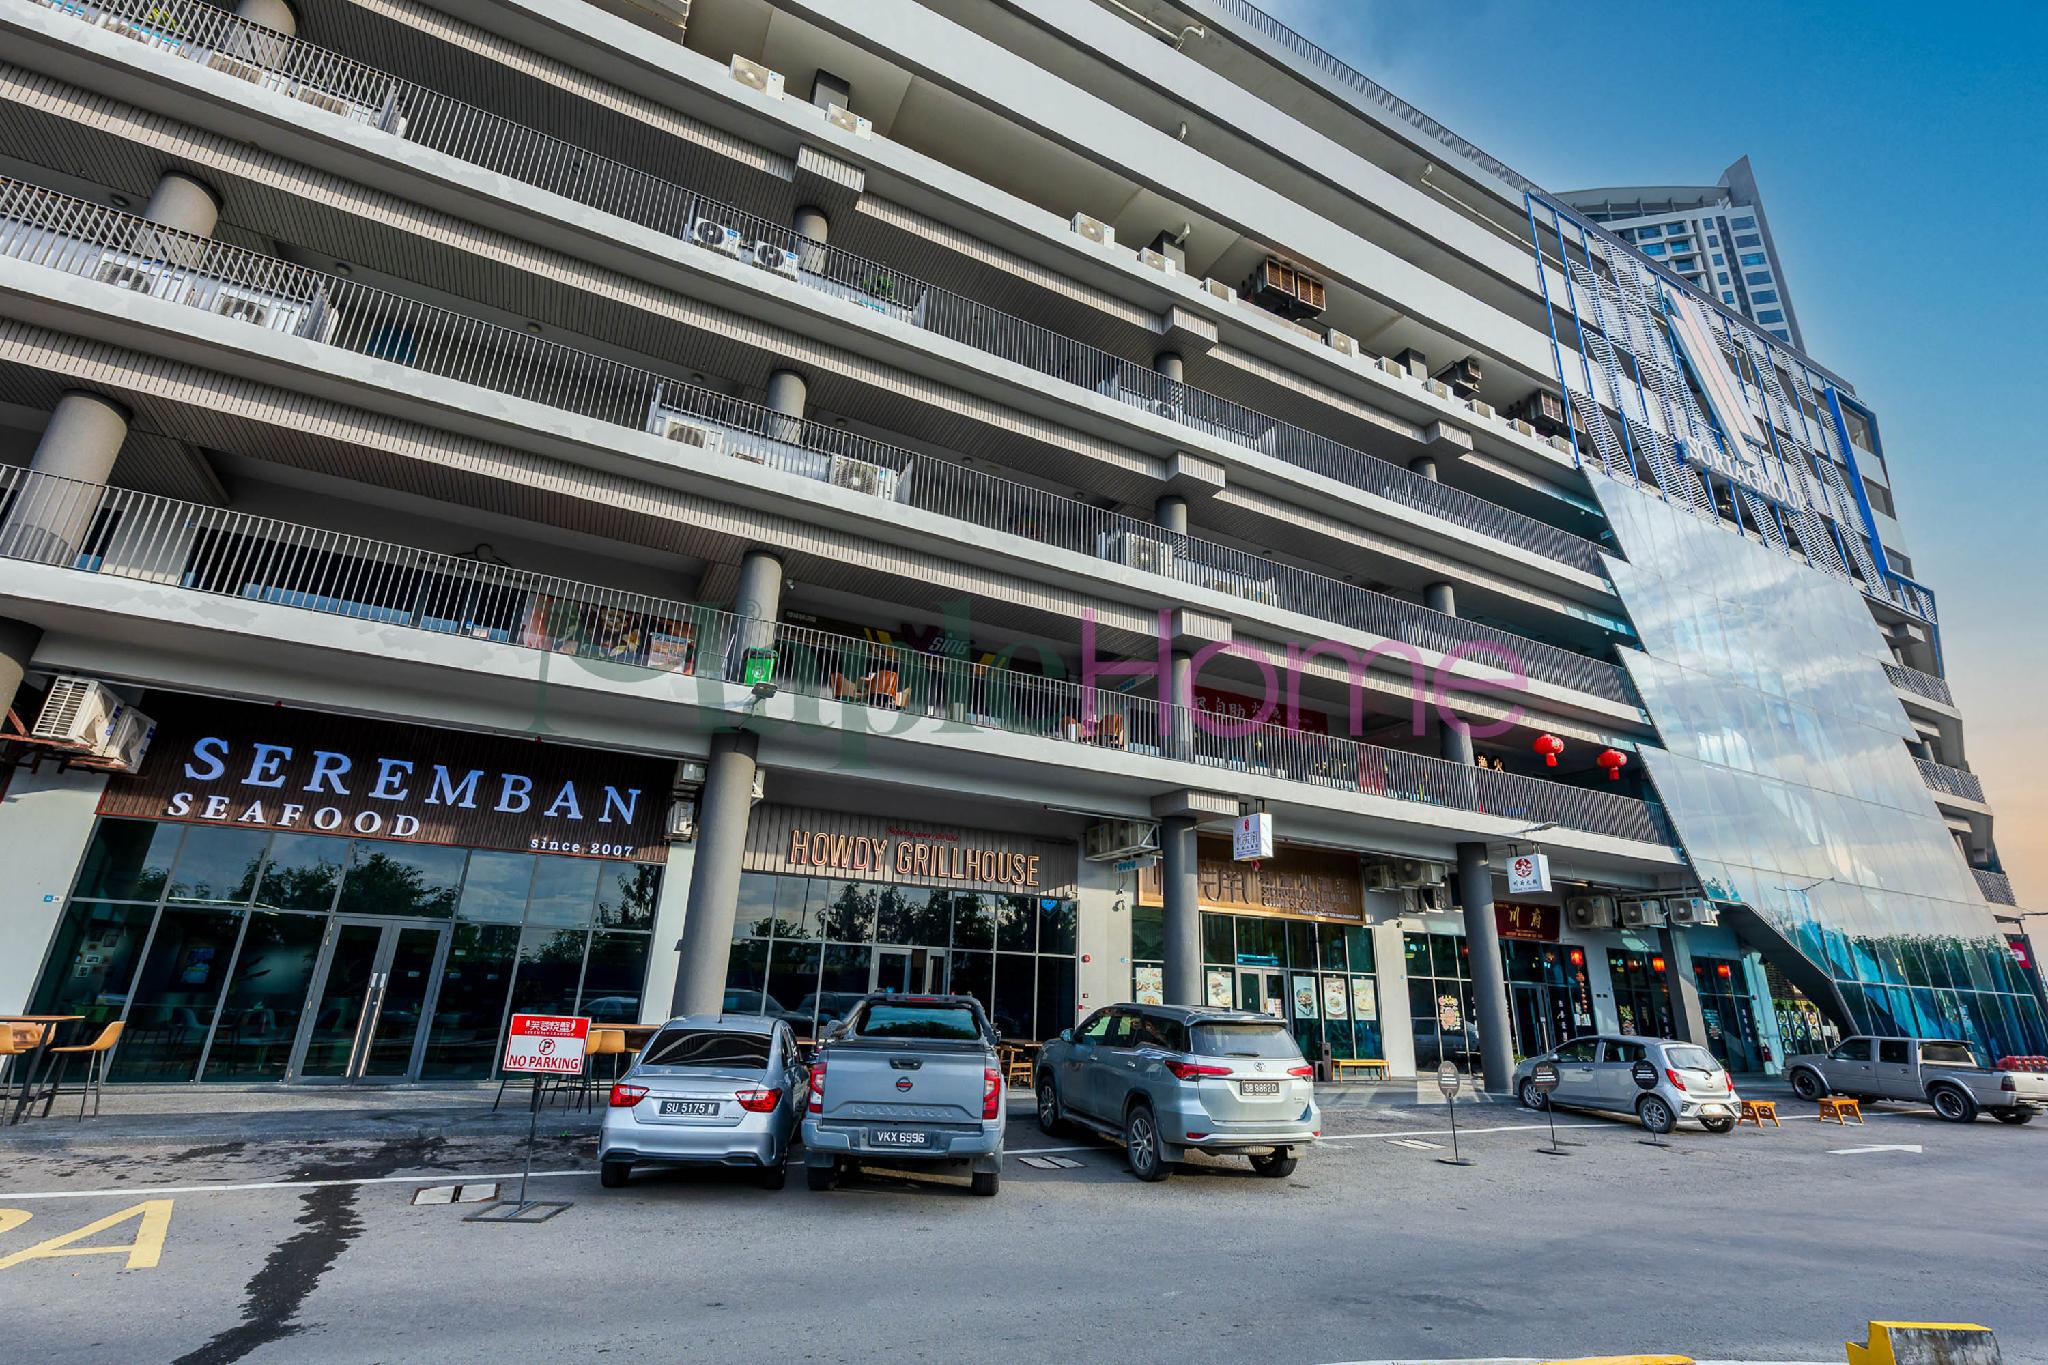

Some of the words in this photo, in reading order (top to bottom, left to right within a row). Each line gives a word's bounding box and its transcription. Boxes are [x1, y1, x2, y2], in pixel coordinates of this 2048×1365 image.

[184, 736, 642, 825] SEREMBAN
[167, 792, 421, 837] SEAFOOD
[530, 837, 584, 854] since
[590, 841, 634, 857] 2007
[789, 829, 888, 871] HOWDY
[896, 841, 1040, 886] GRILLHOUSE
[509, 1055, 526, 1067] NO
[528, 1056, 579, 1070] PARKING
[666, 1102, 679, 1113] SU
[681, 1103, 706, 1113] 5175
[877, 1131, 898, 1143] VKX
[899, 1132, 925, 1144] 6996
